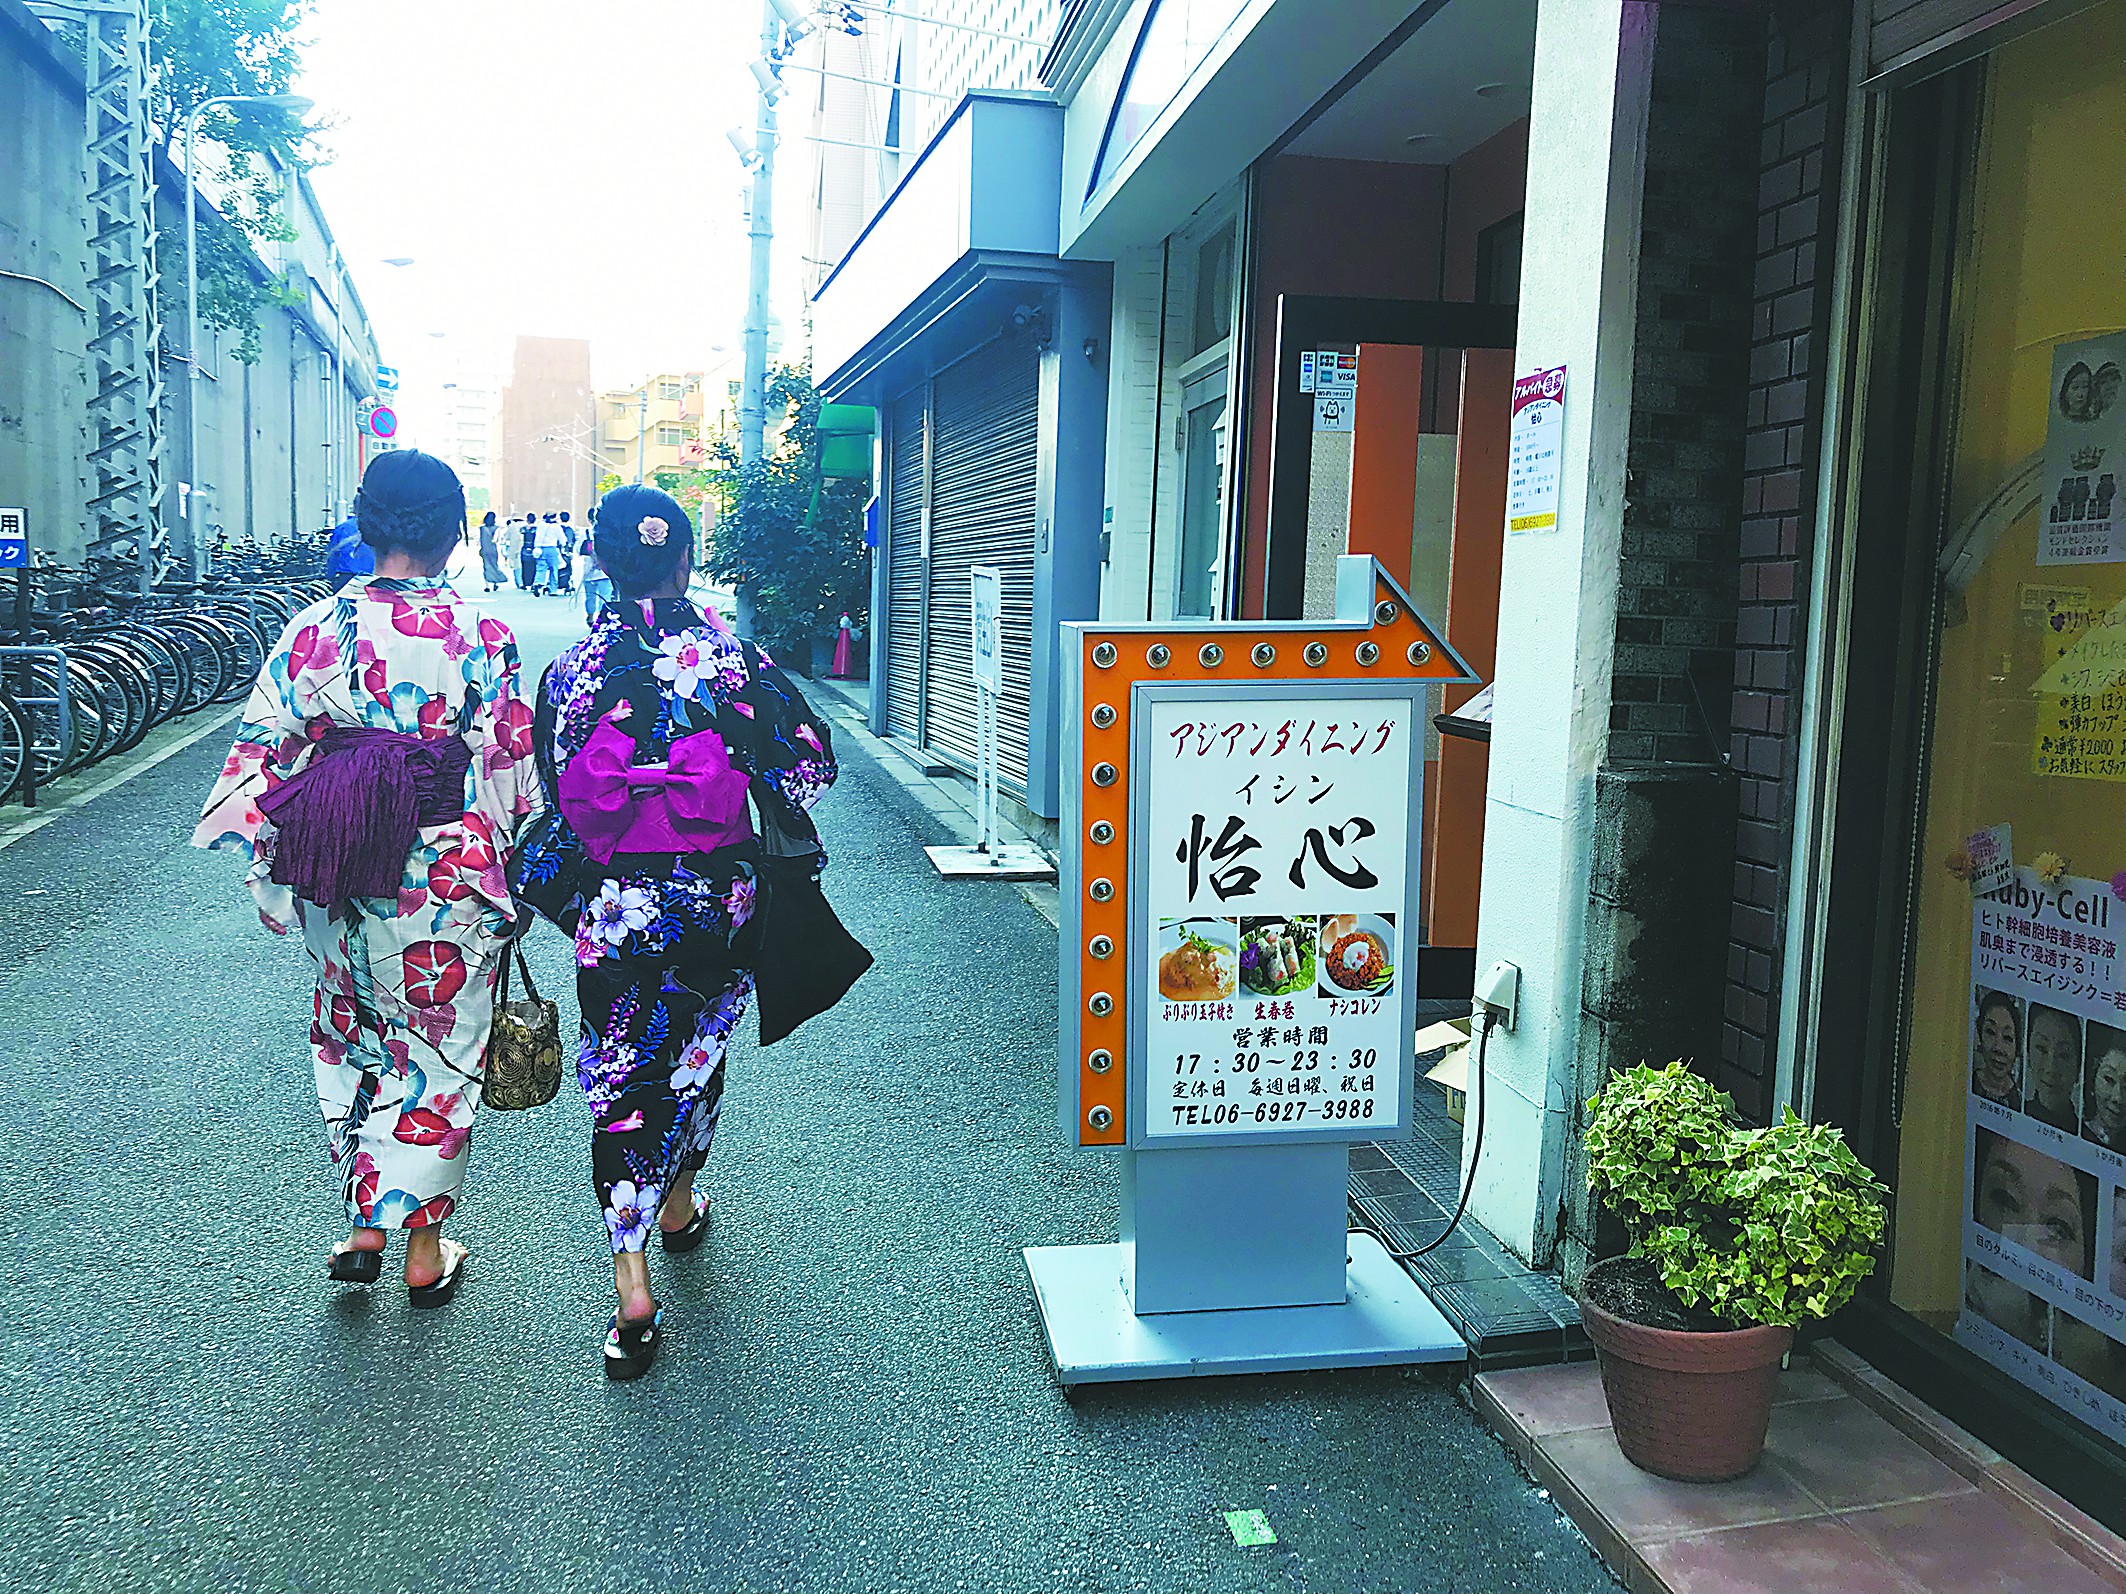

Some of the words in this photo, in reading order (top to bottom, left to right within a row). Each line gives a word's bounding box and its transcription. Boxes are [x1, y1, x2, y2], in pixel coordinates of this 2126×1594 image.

[1337, 373, 1356, 381] VISA
[1169, 718, 1396, 759] アジアンダイニング
[1235, 773, 1336, 805] イシン
[1175, 813, 1379, 903] 怡心
[1981, 910, 2118, 960] ヒト幹細胞培養美容液
[1254, 1001, 1295, 1021] 生春巻
[1329, 999, 1382, 1017] ナシコレン
[1232, 1025, 1329, 1049] 営業時間
[1172, 1079, 1226, 1099] 定休日
